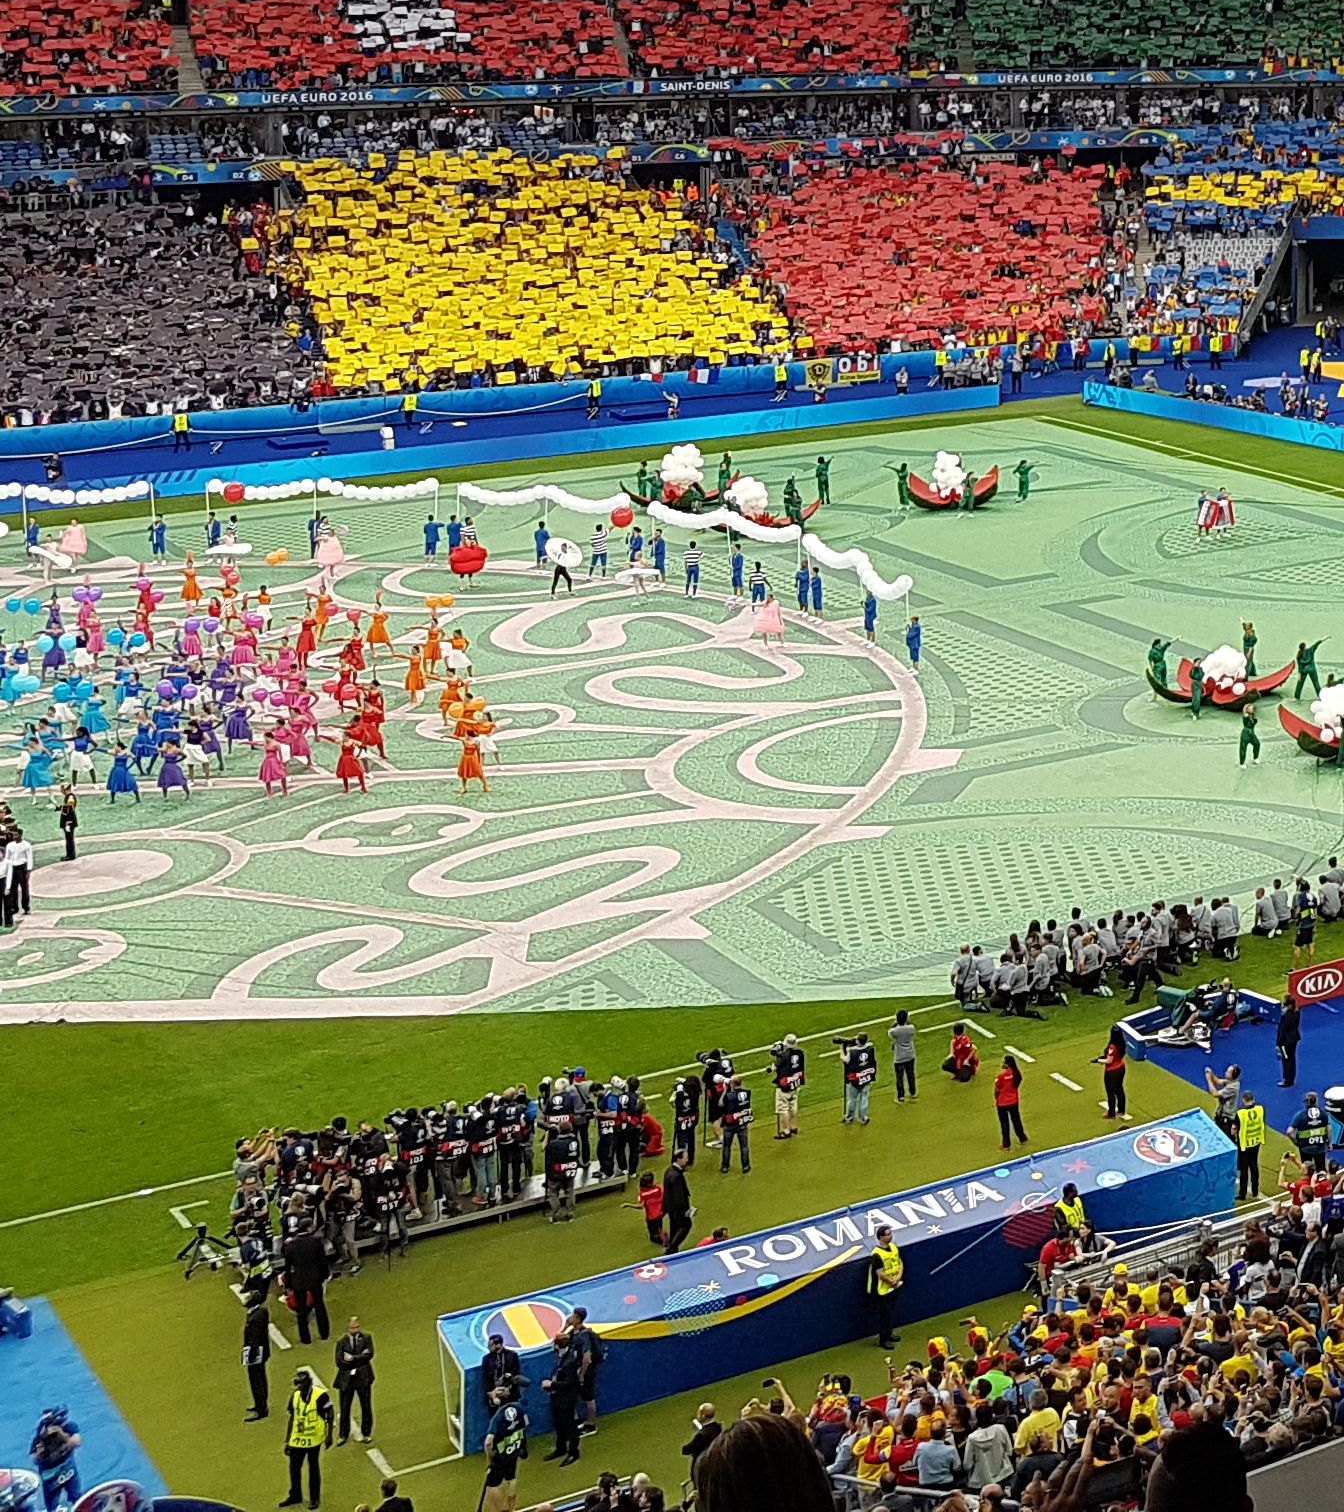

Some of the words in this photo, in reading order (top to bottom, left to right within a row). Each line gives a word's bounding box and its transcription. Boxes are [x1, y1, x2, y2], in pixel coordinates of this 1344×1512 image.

[998, 74, 1028, 84] UEFA
[1030, 73, 1063, 83] EURO
[1064, 72, 1094, 83] 2016
[660, 79, 731, 92] SAINT-DENIS
[261, 93, 298, 105] UEFA
[300, 92, 337, 104] EURO
[339, 90, 374, 102] 2016
[1302, 974, 1336, 995] KIA
[714, 1177, 1007, 1277] ROMANIA
[292, 1437, 312, 1446] 701
